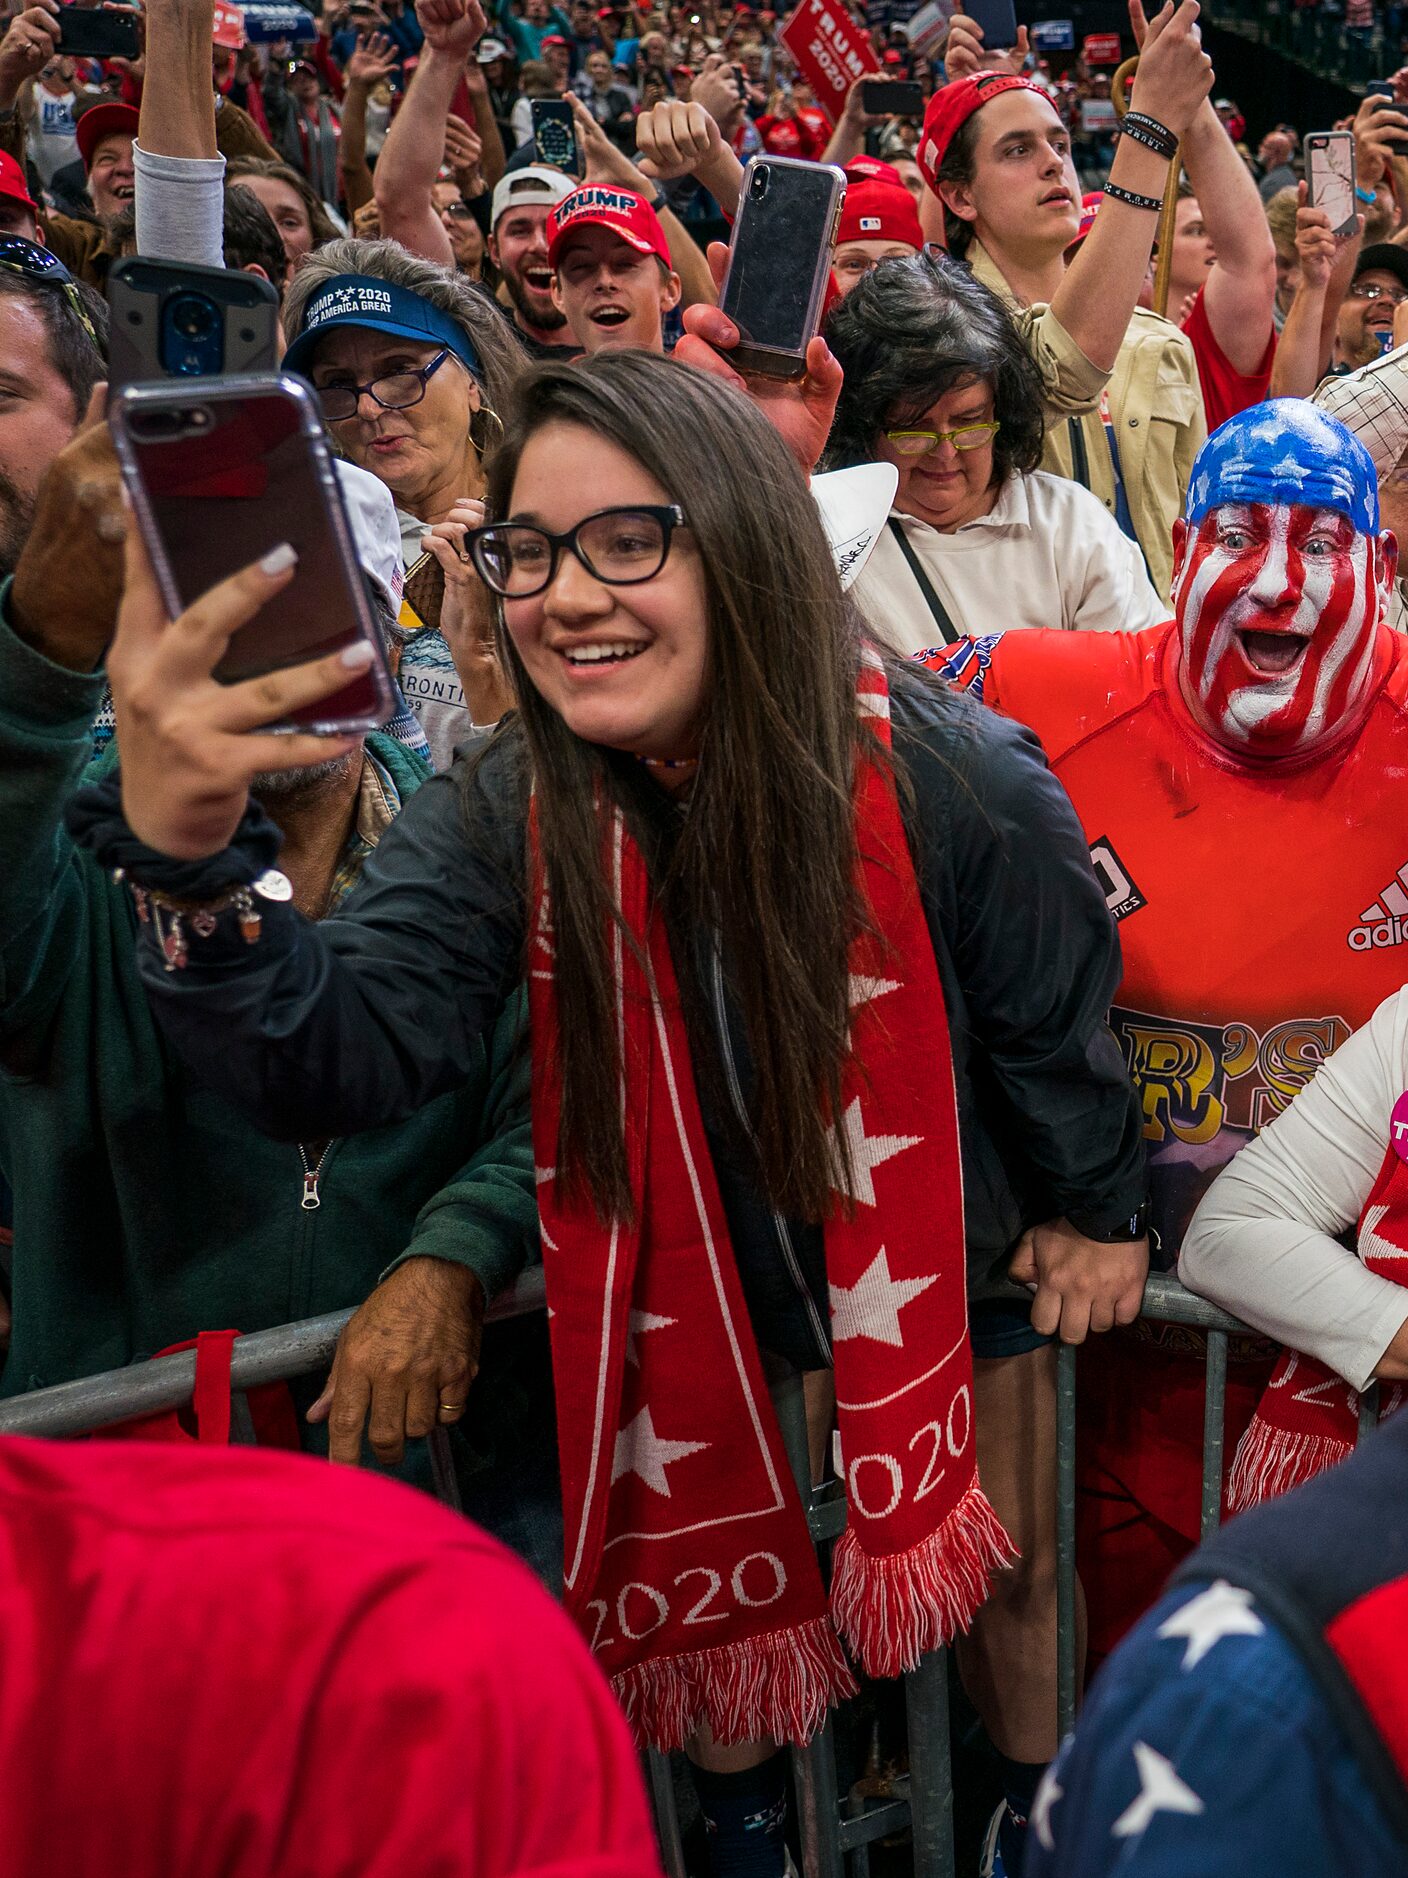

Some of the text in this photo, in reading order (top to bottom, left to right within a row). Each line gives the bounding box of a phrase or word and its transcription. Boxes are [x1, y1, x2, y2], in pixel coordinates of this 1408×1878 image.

[808, 38, 847, 92] 2020
[1127, 128, 1160, 151] TRUMP
[1151, 123, 1168, 136] KEEP
[554, 189, 638, 224] TRUMP
[1114, 188, 1157, 207] TRUMP
[306, 287, 392, 322] TRUMP 2020
[320, 300, 360, 322] AMERICA
[360, 300, 393, 313] GREAT
[404, 697, 422, 711] 59
[1111, 896, 1141, 918] TICS
[585, 1550, 788, 1656] 2020
